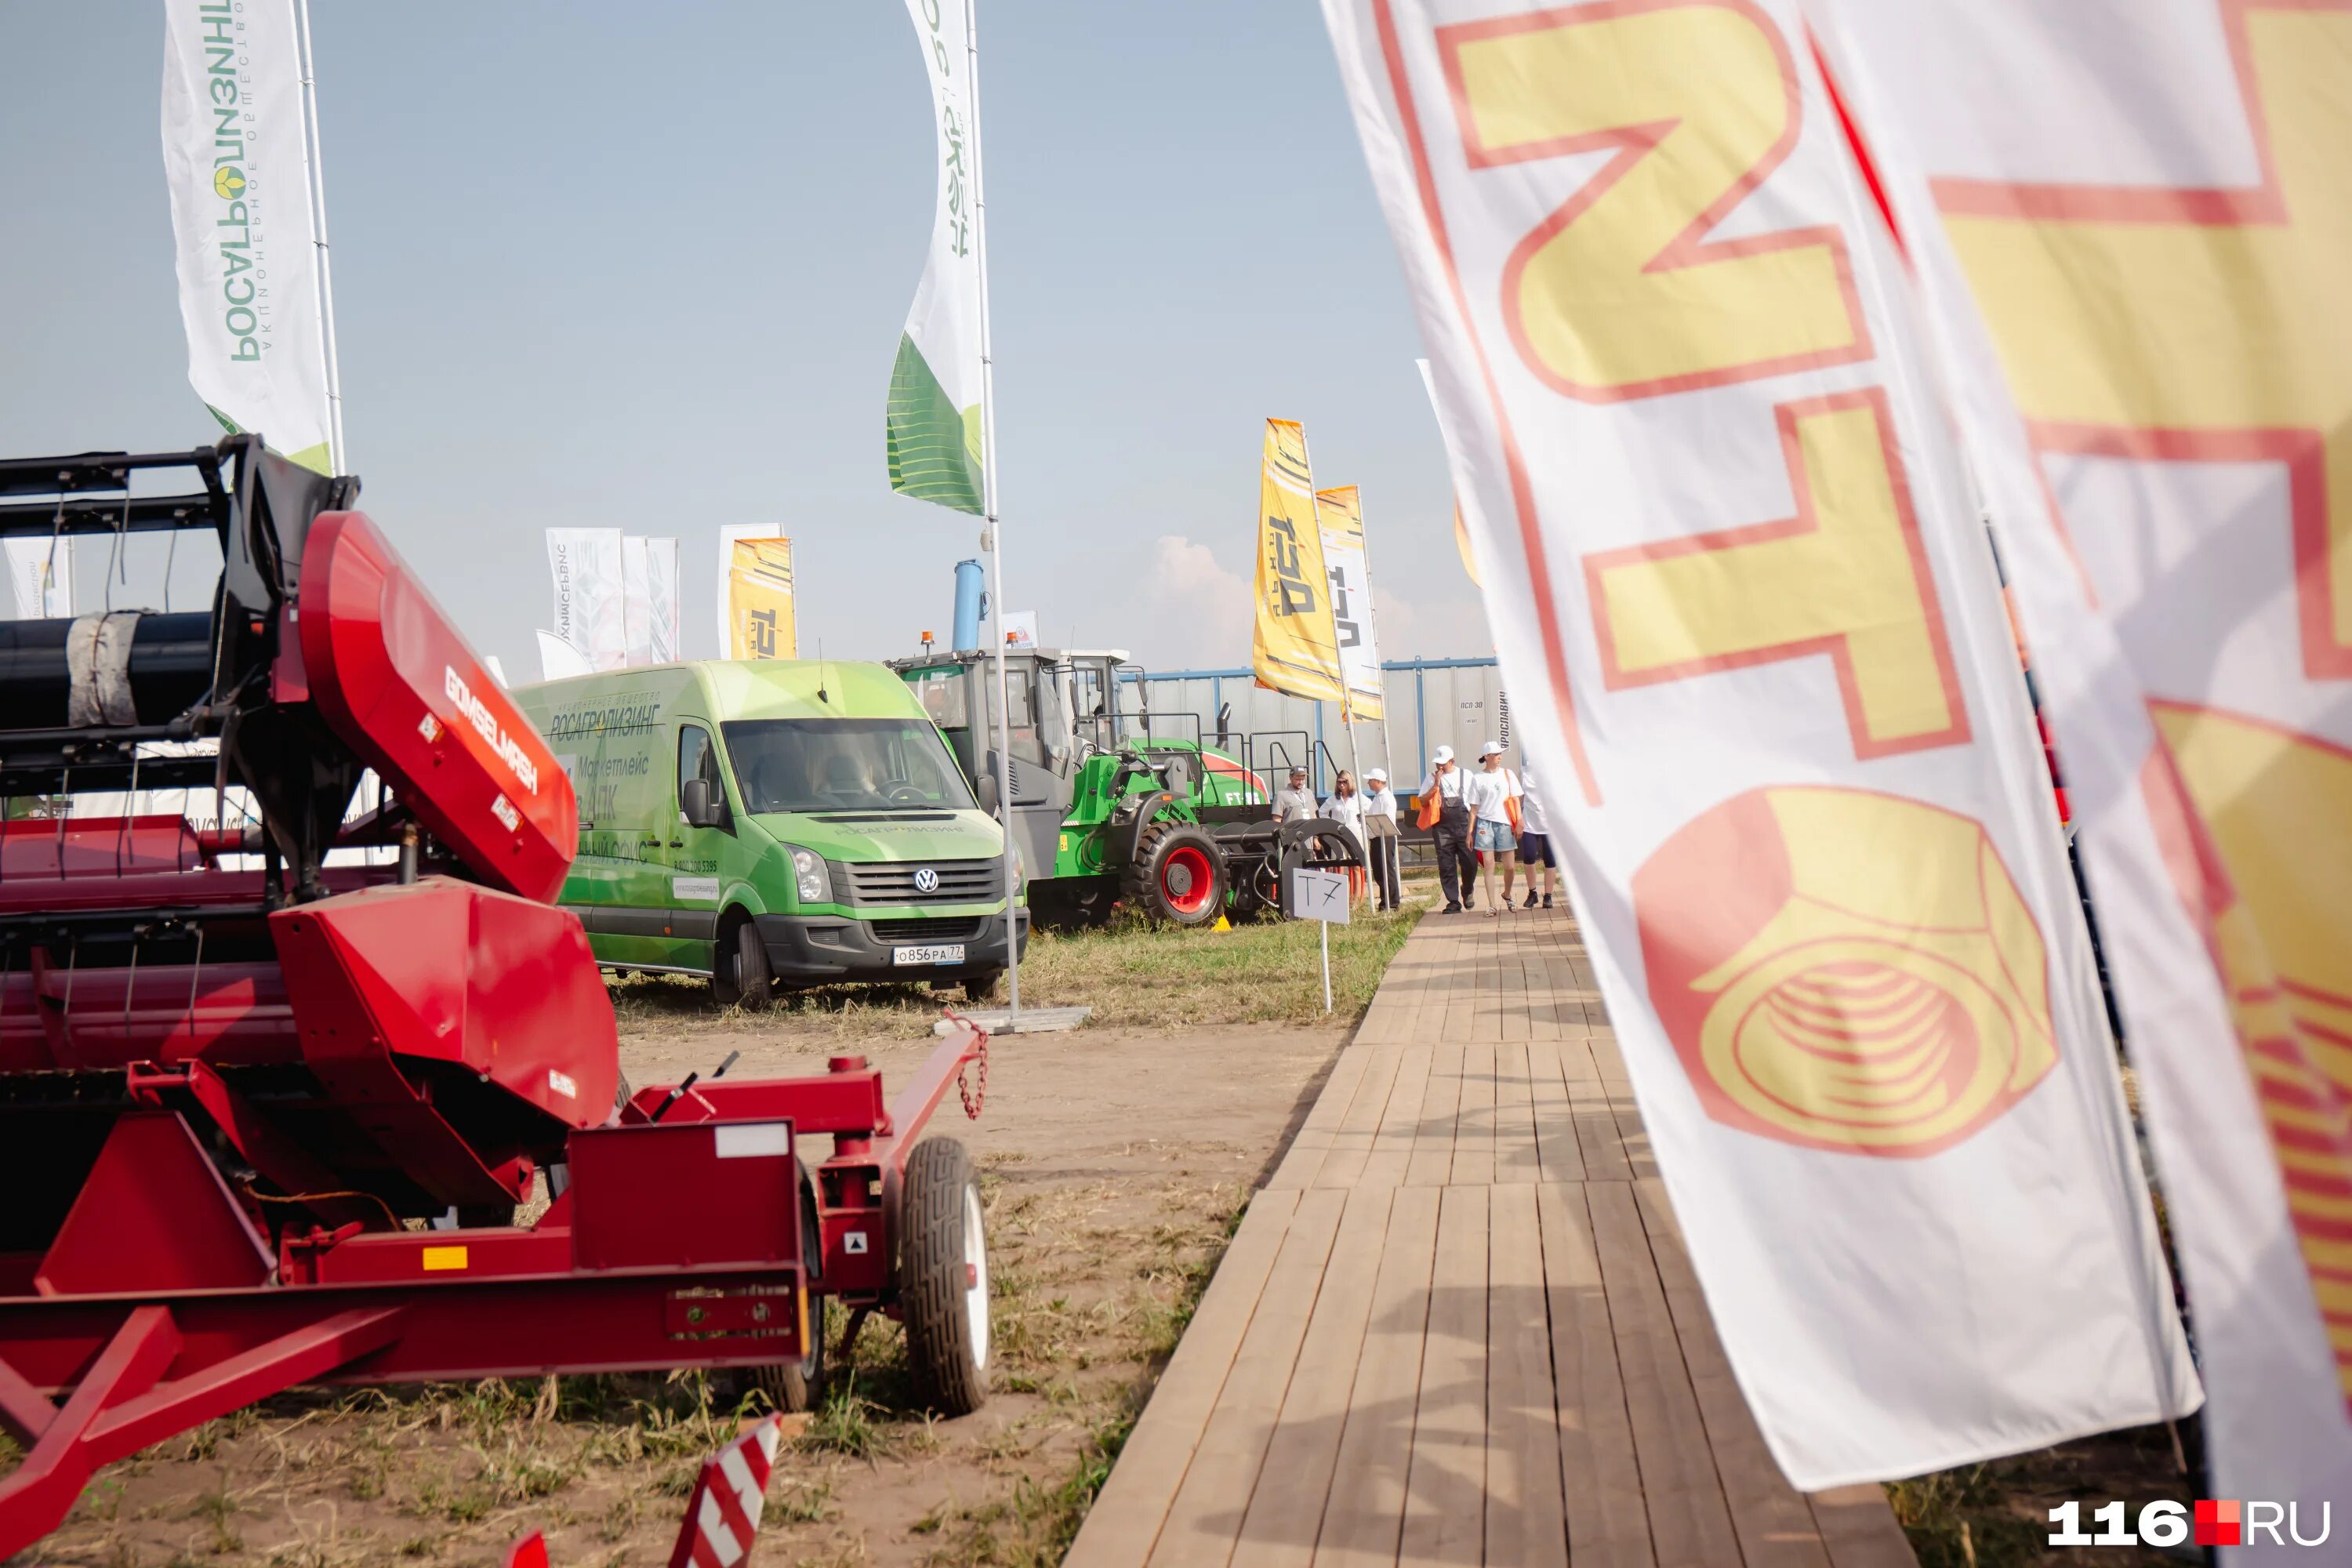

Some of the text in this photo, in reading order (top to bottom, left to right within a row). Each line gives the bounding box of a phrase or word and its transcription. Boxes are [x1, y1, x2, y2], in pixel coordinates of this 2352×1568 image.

[445, 664, 538, 797] GOMSELMASH
[550, 704, 661, 743] РОСАГРОЛИЗИНГ
[578, 750, 649, 779] Маркетплейс
[702, 860, 717, 872] 5395
